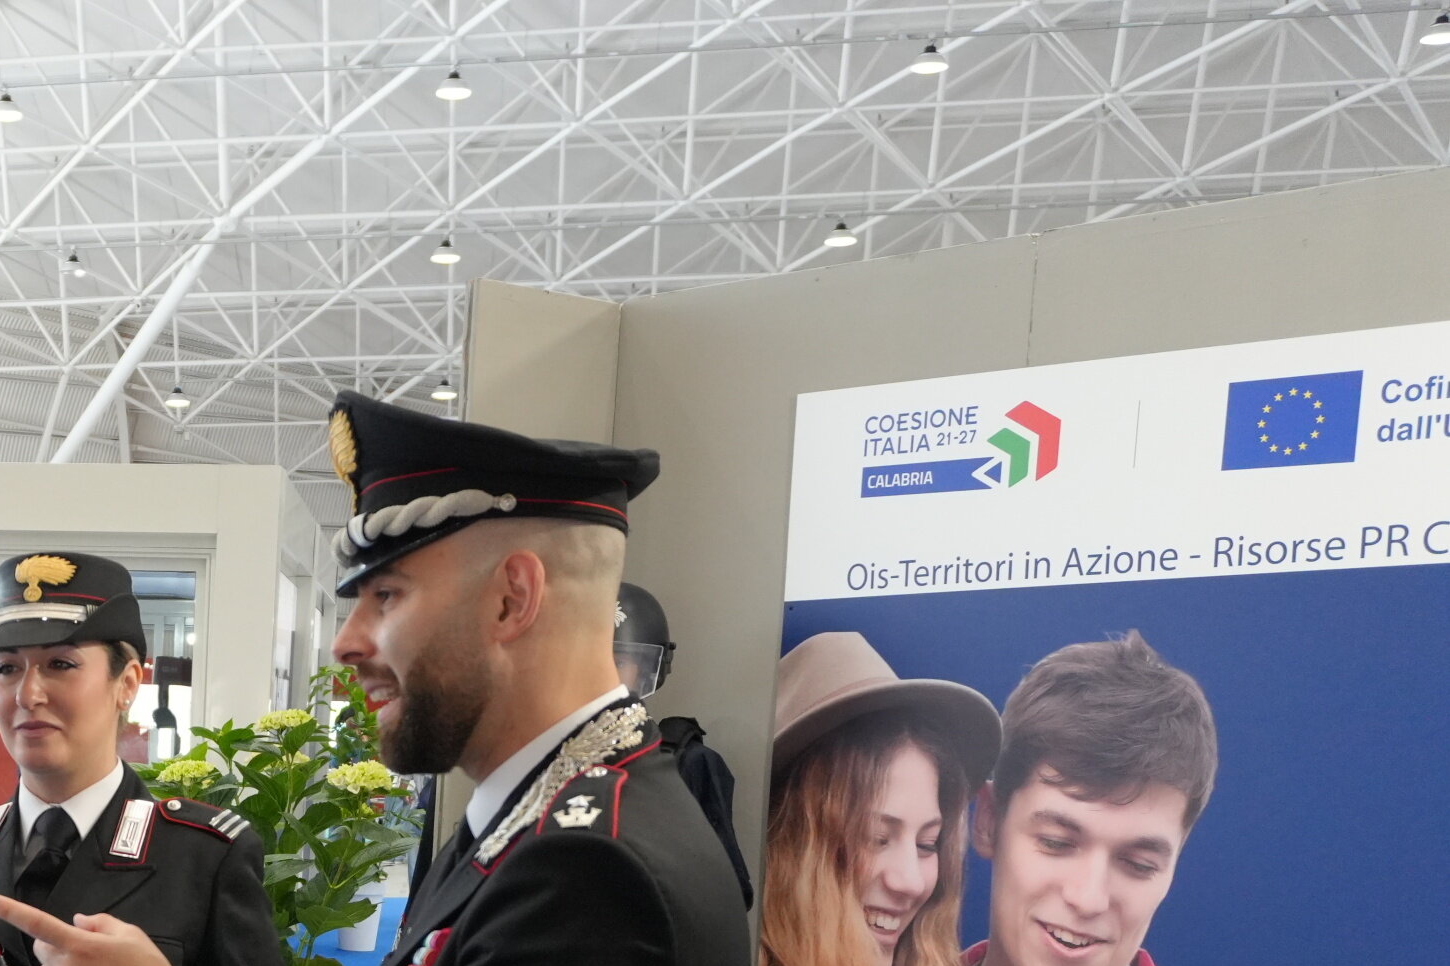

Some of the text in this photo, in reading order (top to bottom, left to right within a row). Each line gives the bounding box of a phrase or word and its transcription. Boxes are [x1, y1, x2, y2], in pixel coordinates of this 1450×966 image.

[1380, 375, 1450, 404] Cofi
[864, 405, 979, 435] COESIONE
[863, 429, 977, 457] ITALIA 21-27
[867, 470, 934, 489] CALABRIA
[846, 552, 1014, 591] Ois-Territori
[1024, 551, 1051, 580] in
[1061, 545, 1178, 578] Azione
[1212, 535, 1346, 568] Risorse
[1359, 524, 1409, 559] PR
